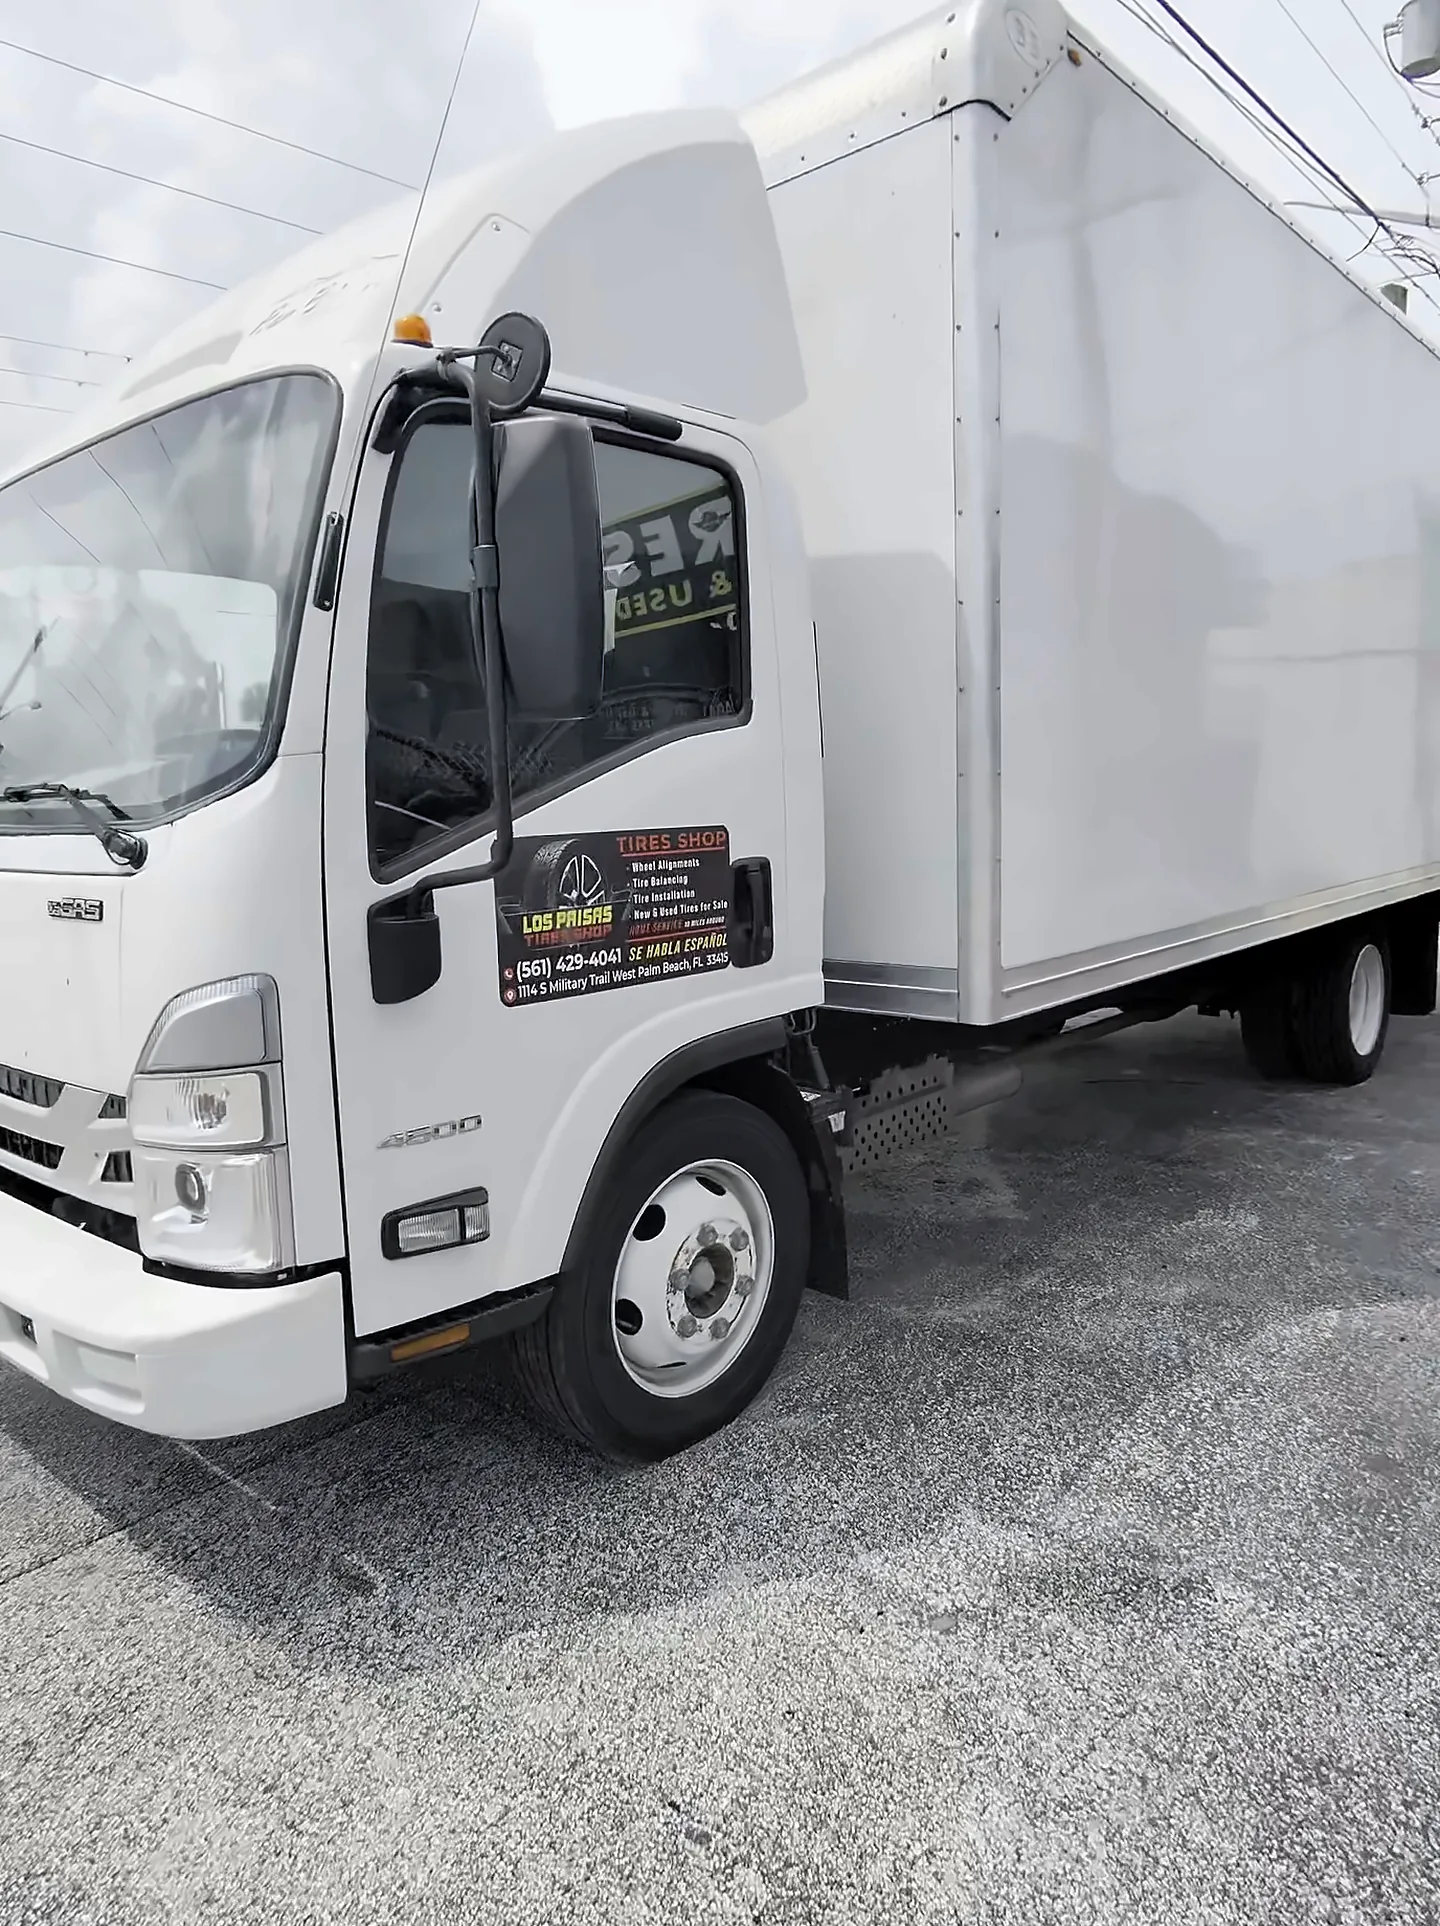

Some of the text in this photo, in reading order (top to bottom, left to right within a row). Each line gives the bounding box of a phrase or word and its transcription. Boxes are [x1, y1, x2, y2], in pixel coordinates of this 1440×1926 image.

[616, 831, 726, 853] TIRES SHOP
[632, 858, 700, 873] Wheel Alignments
[633, 875, 689, 889] Tire Balancing
[633, 889, 696, 904] Tire Installation
[523, 905, 613, 935] LOS PAISAS
[634, 908, 651, 920] New
[660, 904, 678, 917] Used
[680, 902, 699, 914] Tires
[700, 902, 711, 911] for
[713, 900, 728, 910] Sale
[629, 932, 728, 961] SE HABLA ESPAÑOL
[516, 948, 622, 983] (561) 429-4041
[517, 951, 729, 998] 1114 S Military Trail West Palm Beach, FL 33415
[376, 1114, 482, 1149] 4500
